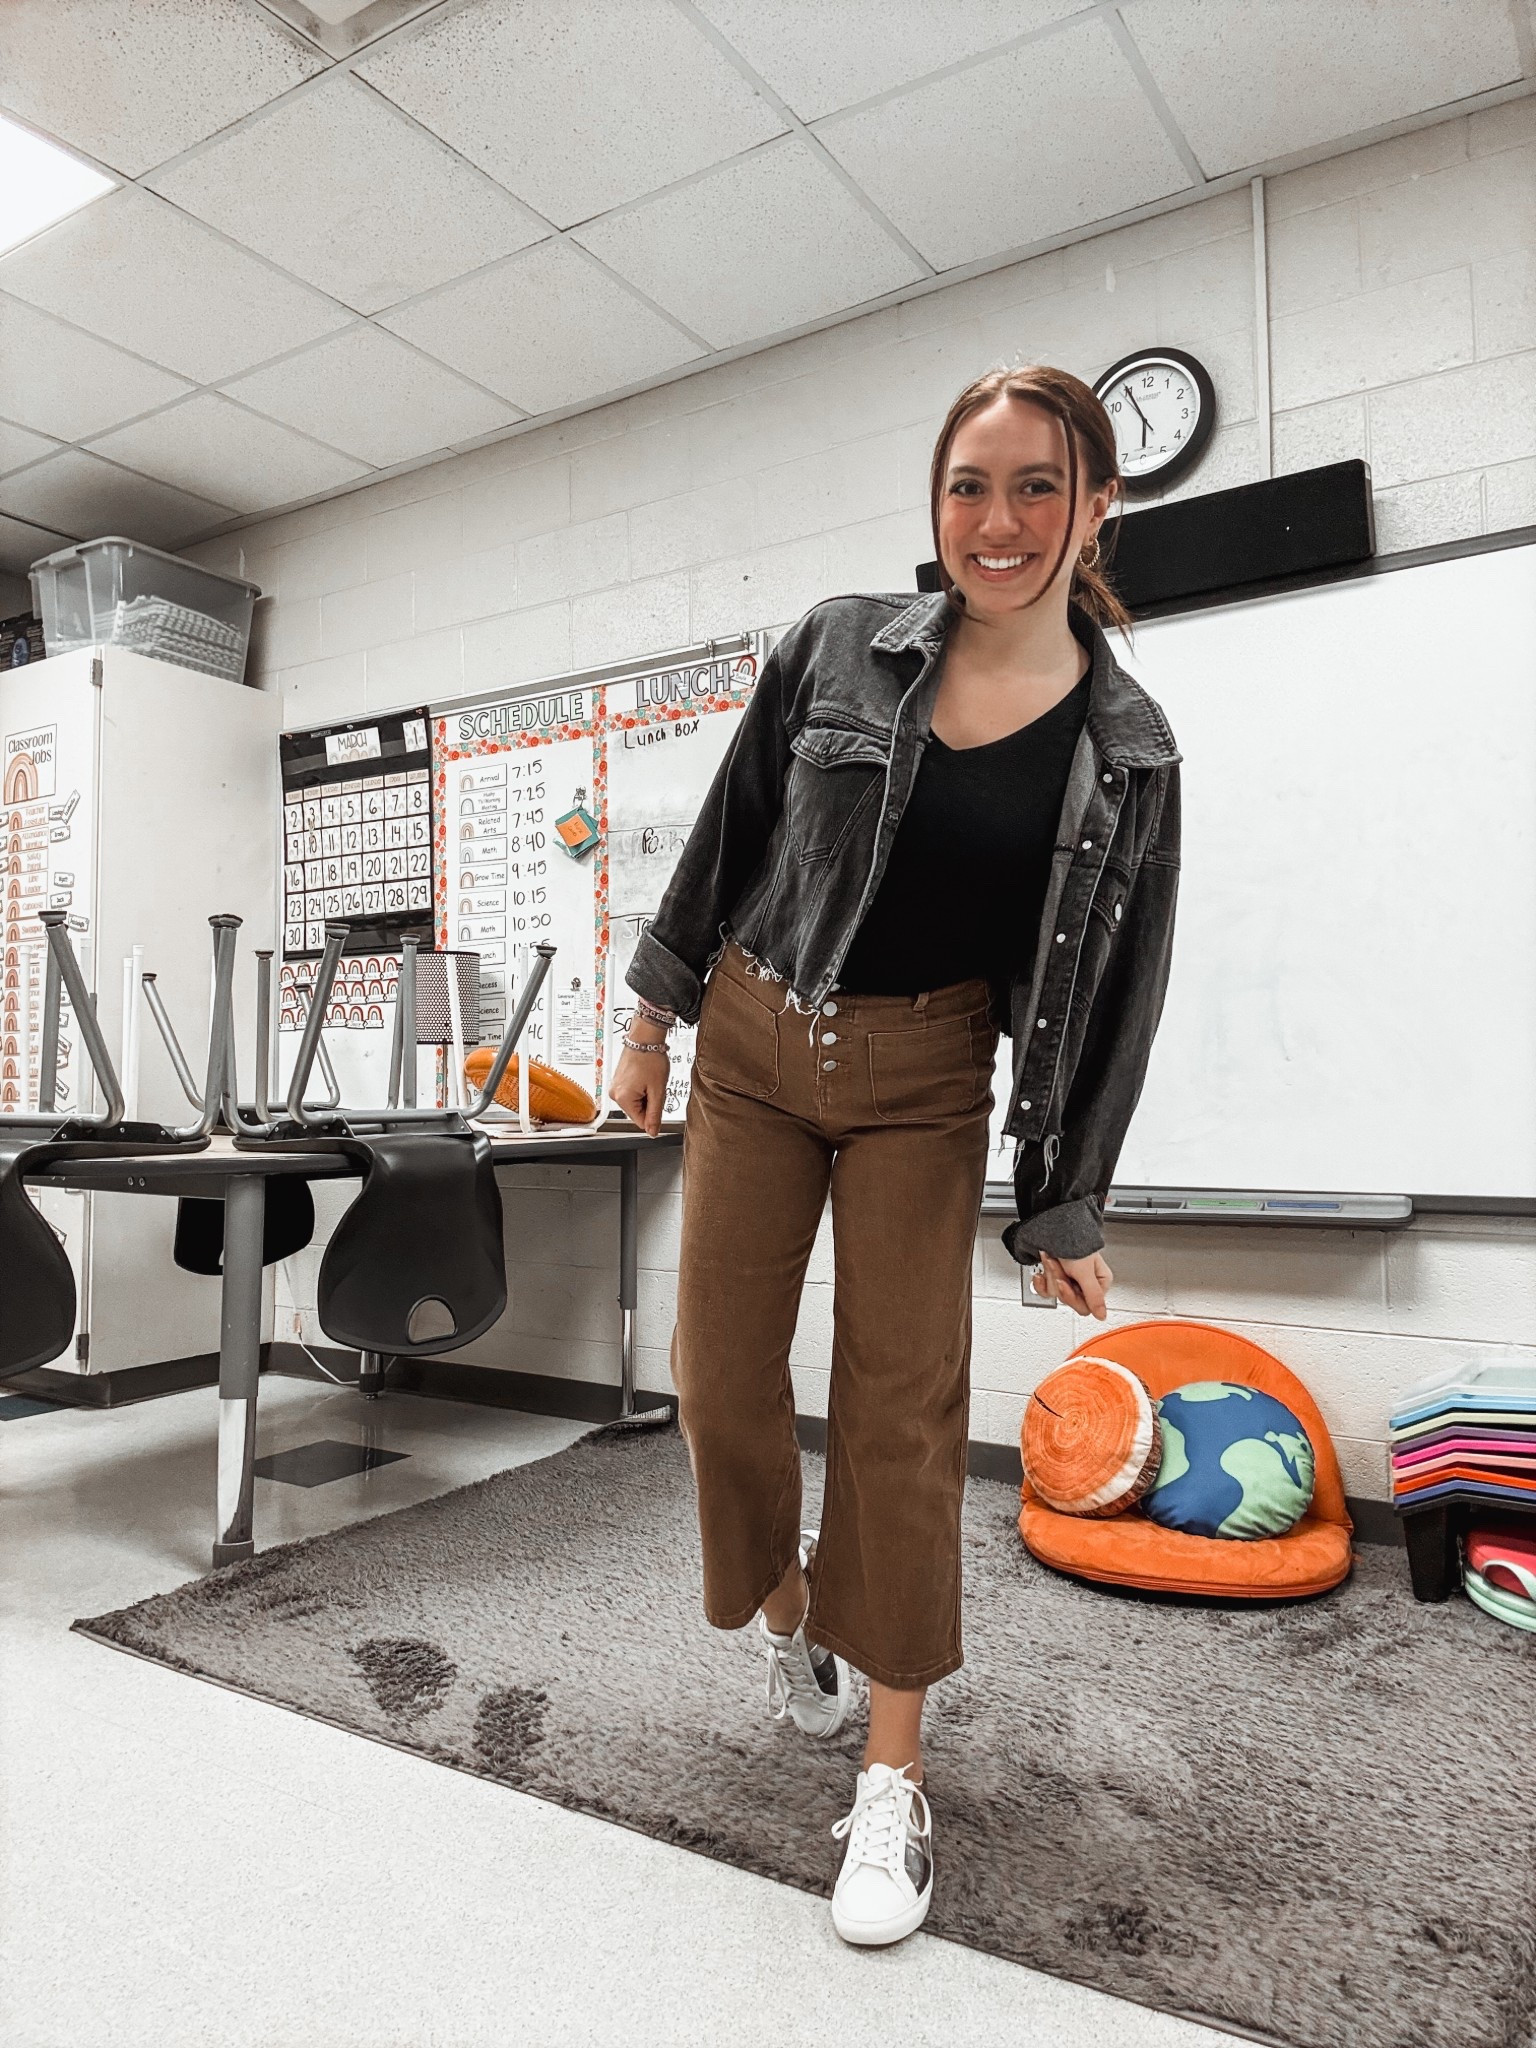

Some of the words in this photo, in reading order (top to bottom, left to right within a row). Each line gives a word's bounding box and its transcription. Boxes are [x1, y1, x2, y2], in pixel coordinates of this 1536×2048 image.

[1142, 376, 1154, 389] 12
[1165, 378, 1170, 389] 1
[1176, 388, 1184, 400] 2
[1110, 402, 1122, 415] 10
[1181, 408, 1188, 419] 3
[1173, 429, 1181, 440] 4
[1121, 453, 1128, 464] 7
[636, 662, 730, 708] LUNCH
[459, 692, 583, 740] SCHEDULE
[8, 732, 53, 753] Classroom
[337, 732, 368, 751] MARCH
[413, 726, 418, 745] 1
[624, 728, 666, 749] Lunch
[675, 719, 700, 737] BOX
[28, 749, 52, 766] Jobs
[480, 773, 499, 783] Arrival
[511, 759, 543, 779] 7:15
[512, 782, 546, 802] 7:25
[291, 811, 298, 828] 2
[328, 804, 334, 819] 4
[347, 801, 354, 818] 5
[369, 797, 377, 815] 6
[391, 795, 399, 812] 7
[414, 791, 422, 808] 8
[511, 807, 544, 828] 7:45
[478, 816, 501, 825] Related
[292, 839, 299, 856] 9
[328, 834, 335, 851] 11
[347, 831, 357, 849] 12
[368, 828, 378, 846] 13
[391, 826, 401, 843] 14
[413, 822, 423, 840] 15
[511, 831, 545, 853] 8:40
[290, 870, 300, 887] 16
[310, 867, 318, 884] 17
[328, 864, 337, 882] 18
[347, 861, 357, 879] 19
[366, 857, 381, 877] 20
[390, 855, 402, 875] 21
[410, 853, 427, 872] 22
[511, 860, 547, 879] 9:45
[289, 900, 302, 917] 23
[308, 898, 321, 915] 24
[327, 895, 340, 913] 25
[345, 892, 360, 911] 26
[366, 891, 380, 909] 27
[388, 889, 404, 907] 28
[411, 885, 427, 904] 29
[513, 887, 547, 906] 10:15
[512, 913, 552, 932] 10:50
[288, 927, 301, 946] 30
[310, 927, 320, 945] 31
